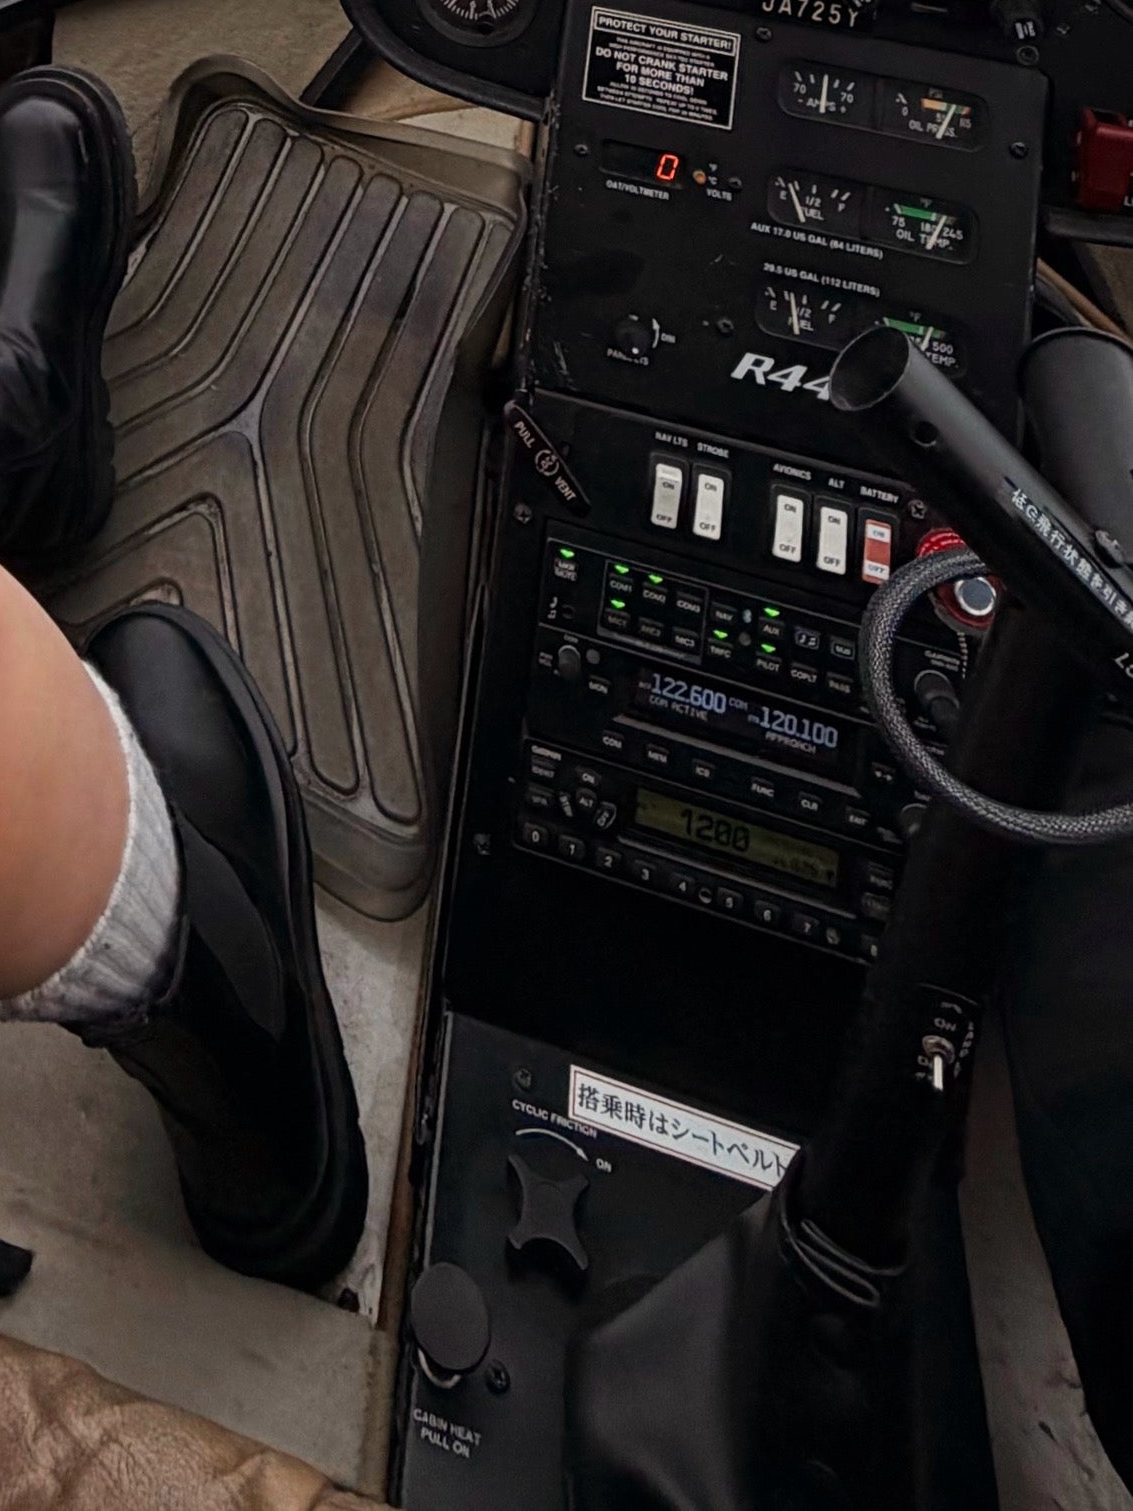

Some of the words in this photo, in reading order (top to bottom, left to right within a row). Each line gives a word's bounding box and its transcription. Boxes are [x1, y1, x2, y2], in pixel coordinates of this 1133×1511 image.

[598, 16, 648, 33] PROTECT
[649, 25, 678, 39] YOUR
[680, 33, 732, 50] STARTER!
[595, 46, 612, 58] DO
[614, 50, 636, 62] NOT
[638, 55, 677, 71] CRANK
[678, 63, 728, 81] STARTER
[616, 61, 639, 74] FOR
[640, 66, 673, 80] MORE
[675, 71, 705, 87] THAN
[624, 74, 637, 84] 10
[638, 76, 694, 95] SECONDS!
[793, 82, 807, 95] 70
[840, 91, 854, 104] 70
[908, 119, 924, 132] OIL
[655, 152, 680, 181] 0
[605, 179, 670, 201] OAT/VOLTMETER
[706, 188, 733, 202] VOLTS
[779, 190, 787, 200] E
[805, 195, 822, 208] 1/2
[891, 214, 906, 228] 75
[942, 226, 964, 241] 245
[895, 228, 915, 242] OIL
[750, 222, 771, 234] AUX
[773, 227, 792, 239] 17.0
[793, 231, 807, 242] US
[807, 234, 828, 247] GAL
[845, 242, 884, 261] LITERS)
[784, 267, 798, 278] US
[799, 270, 819, 283] GAL
[821, 275, 842, 288] (112
[842, 280, 881, 299] LITERS)
[769, 299, 778, 311] E
[932, 341, 954, 355] 500
[730, 351, 830, 401] R44
[513, 420, 536, 449] PULL
[655, 431, 671, 442] NAV
[672, 436, 689, 448] LTS
[697, 442, 730, 459] STROBE
[772, 463, 812, 481] AVIONICS
[828, 477, 846, 489] ALT
[860, 485, 900, 504] BATTERY
[554, 475, 577, 501] VENT
[662, 481, 674, 490] ON
[656, 513, 673, 524] OFF
[699, 521, 716, 532] OFF
[778, 543, 796, 554] OFF
[823, 556, 841, 567] OFF
[554, 568, 578, 582] MUTE
[609, 579, 633, 593] COM1
[642, 589, 667, 604] COM2
[676, 599, 701, 614] COM3
[762, 624, 781, 637] AUX
[674, 634, 695, 648] MIC3
[756, 658, 781, 673] PILOT
[790, 669, 818, 684] COPLT
[649, 695, 668, 708] COM
[671, 701, 709, 722] ACTIVE
[651, 672, 727, 715] 122.600
[728, 696, 749, 711] COM
[759, 706, 839, 749] 120.100
[578, 796, 594, 807] ALT
[751, 783, 775, 798] FUNC
[800, 797, 819, 812] CLR
[531, 830, 540, 843] 0
[680, 809, 751, 853] 1200
[604, 855, 613, 868] 2
[641, 868, 650, 881] 3
[678, 880, 687, 892] 4
[763, 908, 772, 922] 6
[803, 921, 812, 934] 7
[933, 1017, 957, 1032] ON
[512, 1098, 550, 1122] CYCLIC
[550, 1111, 598, 1139] FRICTION
[578, 1082, 788, 1177] 搭乗時はシートベルト
[595, 1157, 613, 1174] ON
[413, 1408, 448, 1432] CABIN
[450, 1422, 482, 1446] HEAT
[420, 1426, 451, 1451] PULL
[452, 1440, 470, 1458] ON
